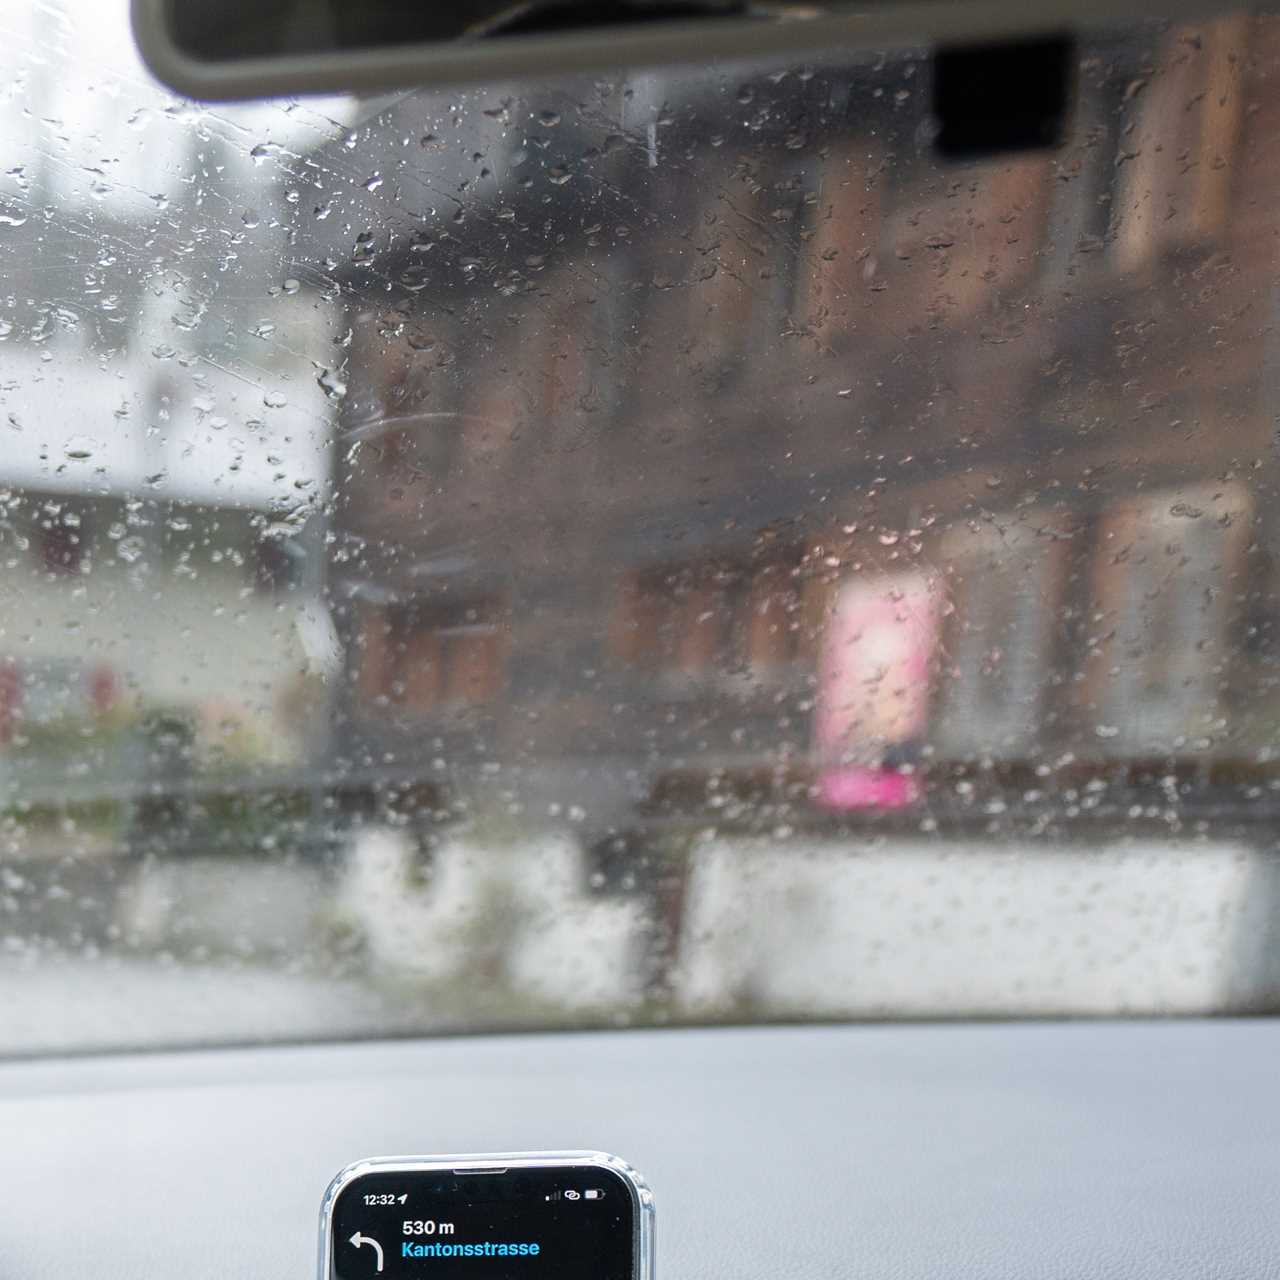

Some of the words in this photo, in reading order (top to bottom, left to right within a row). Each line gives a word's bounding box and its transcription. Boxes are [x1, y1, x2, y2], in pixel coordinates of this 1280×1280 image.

[364, 1194, 395, 1205] 12:32
[403, 1221, 435, 1235] 530
[439, 1224, 454, 1234] m
[402, 1242, 539, 1257] Kantonsstrasse
